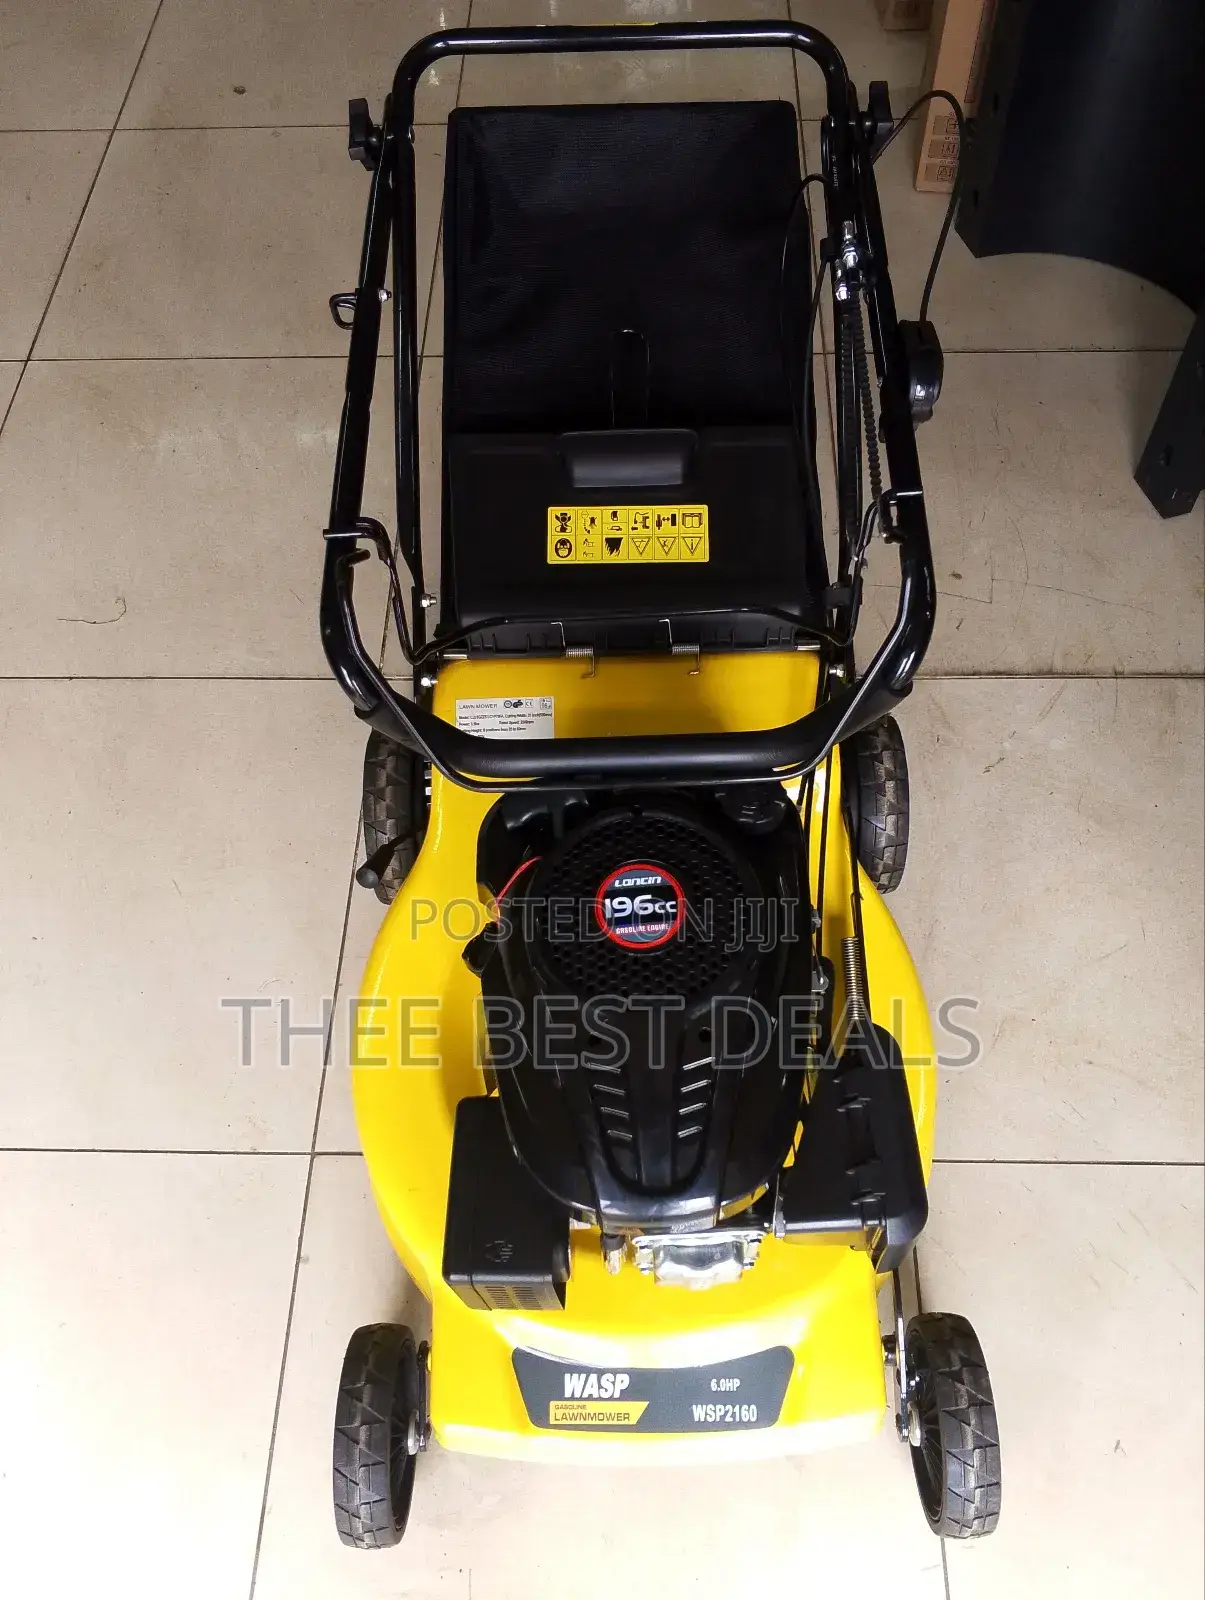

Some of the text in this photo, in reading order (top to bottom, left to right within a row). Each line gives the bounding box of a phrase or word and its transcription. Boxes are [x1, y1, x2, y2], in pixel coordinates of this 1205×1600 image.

[604, 894, 677, 919] 196cc
[616, 924, 670, 934] GASOLINE ENGINE
[564, 1373, 630, 1399] WASP
[710, 1378, 740, 1392] 6.0HP
[554, 1412, 630, 1422] LAWNMOWER
[692, 1404, 758, 1423] WSP2160
